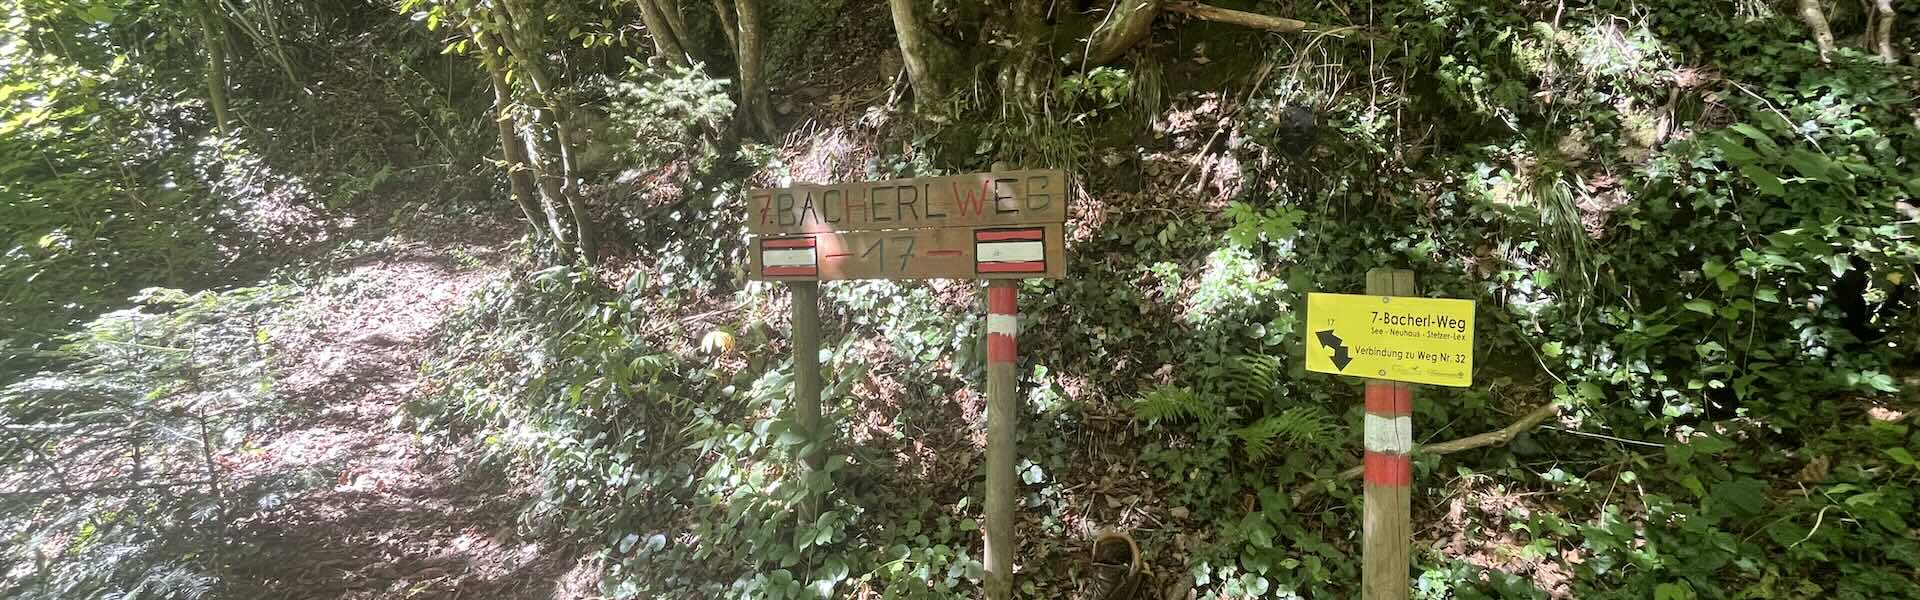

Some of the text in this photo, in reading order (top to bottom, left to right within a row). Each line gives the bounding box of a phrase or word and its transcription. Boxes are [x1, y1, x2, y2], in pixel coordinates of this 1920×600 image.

[953, 176, 1051, 217] WEG
[861, 236, 916, 273] 17
[1371, 311, 1467, 333] 7-Bacherl-Weg
[1371, 327, 1384, 336] See
[1390, 328, 1421, 338] Neuhaus
[1427, 330, 1466, 342] Stelzer-Lex
[1355, 345, 1466, 364] Verbindung zu Weg Nr. 32
